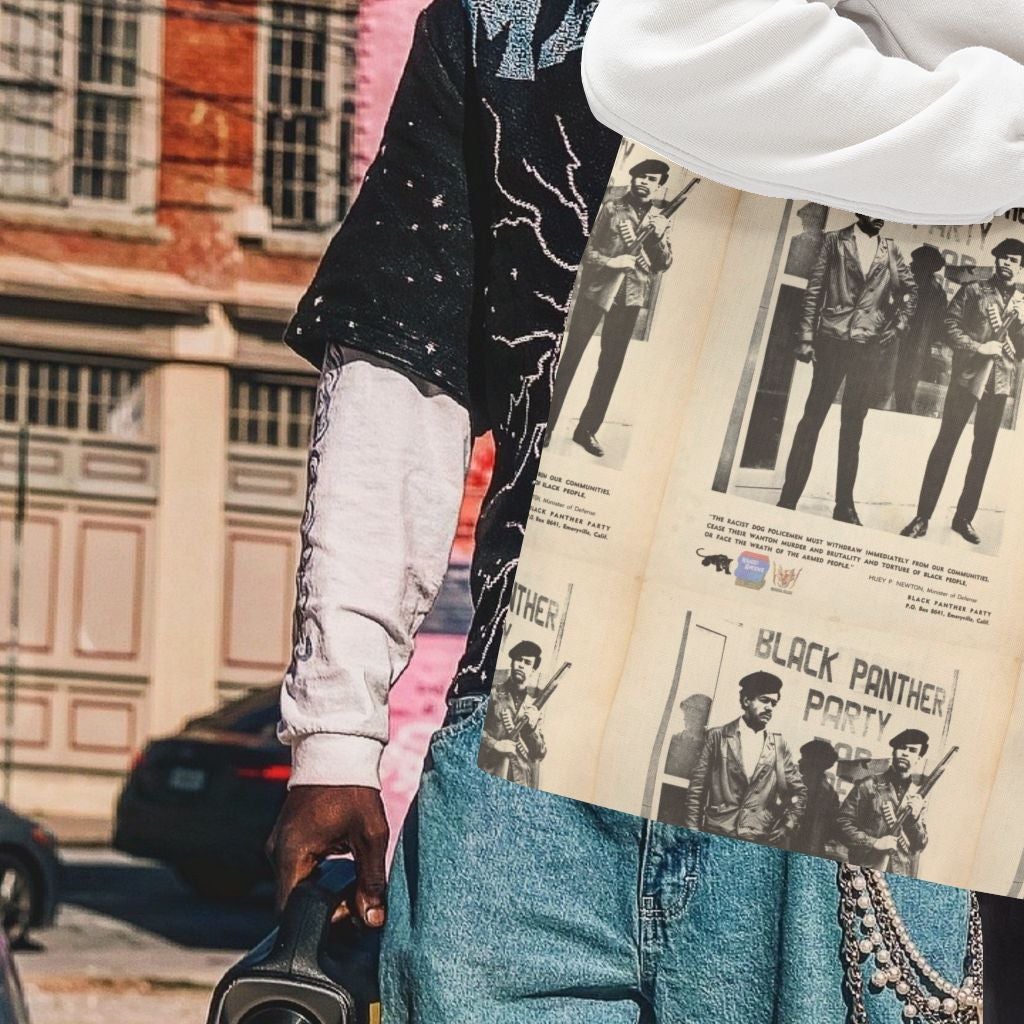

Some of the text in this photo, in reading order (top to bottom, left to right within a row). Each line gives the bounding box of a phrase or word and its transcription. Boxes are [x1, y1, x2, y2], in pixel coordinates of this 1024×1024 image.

[542, 482, 560, 491] BLACK
[550, 511, 583, 524] PANTHER
[588, 521, 611, 531] PARTY
[707, 523, 725, 532] CEASE
[729, 528, 746, 537] THEIR
[750, 533, 778, 544] WANTON
[781, 540, 806, 550] MURDER
[827, 550, 861, 562] BRUTALITY
[882, 562, 909, 573] TORTURE
[924, 572, 942, 580] BLACK
[727, 518, 749, 528] RACIST
[768, 528, 803, 539] POLICEMEN
[806, 537, 823, 545] MUST
[827, 541, 862, 553] WITHDRAW
[866, 550, 909, 564] IMMEDIATELY
[912, 561, 929, 569] FROM
[750, 542, 772, 552] WRATH
[788, 550, 799, 558] THE
[802, 554, 823, 563] ARMED
[869, 575, 886, 584] HUEY
[908, 595, 992, 617] BLACK PANTHER PARTY
[755, 628, 946, 717] BLACK PANTHER
[803, 688, 892, 741] PARTY
